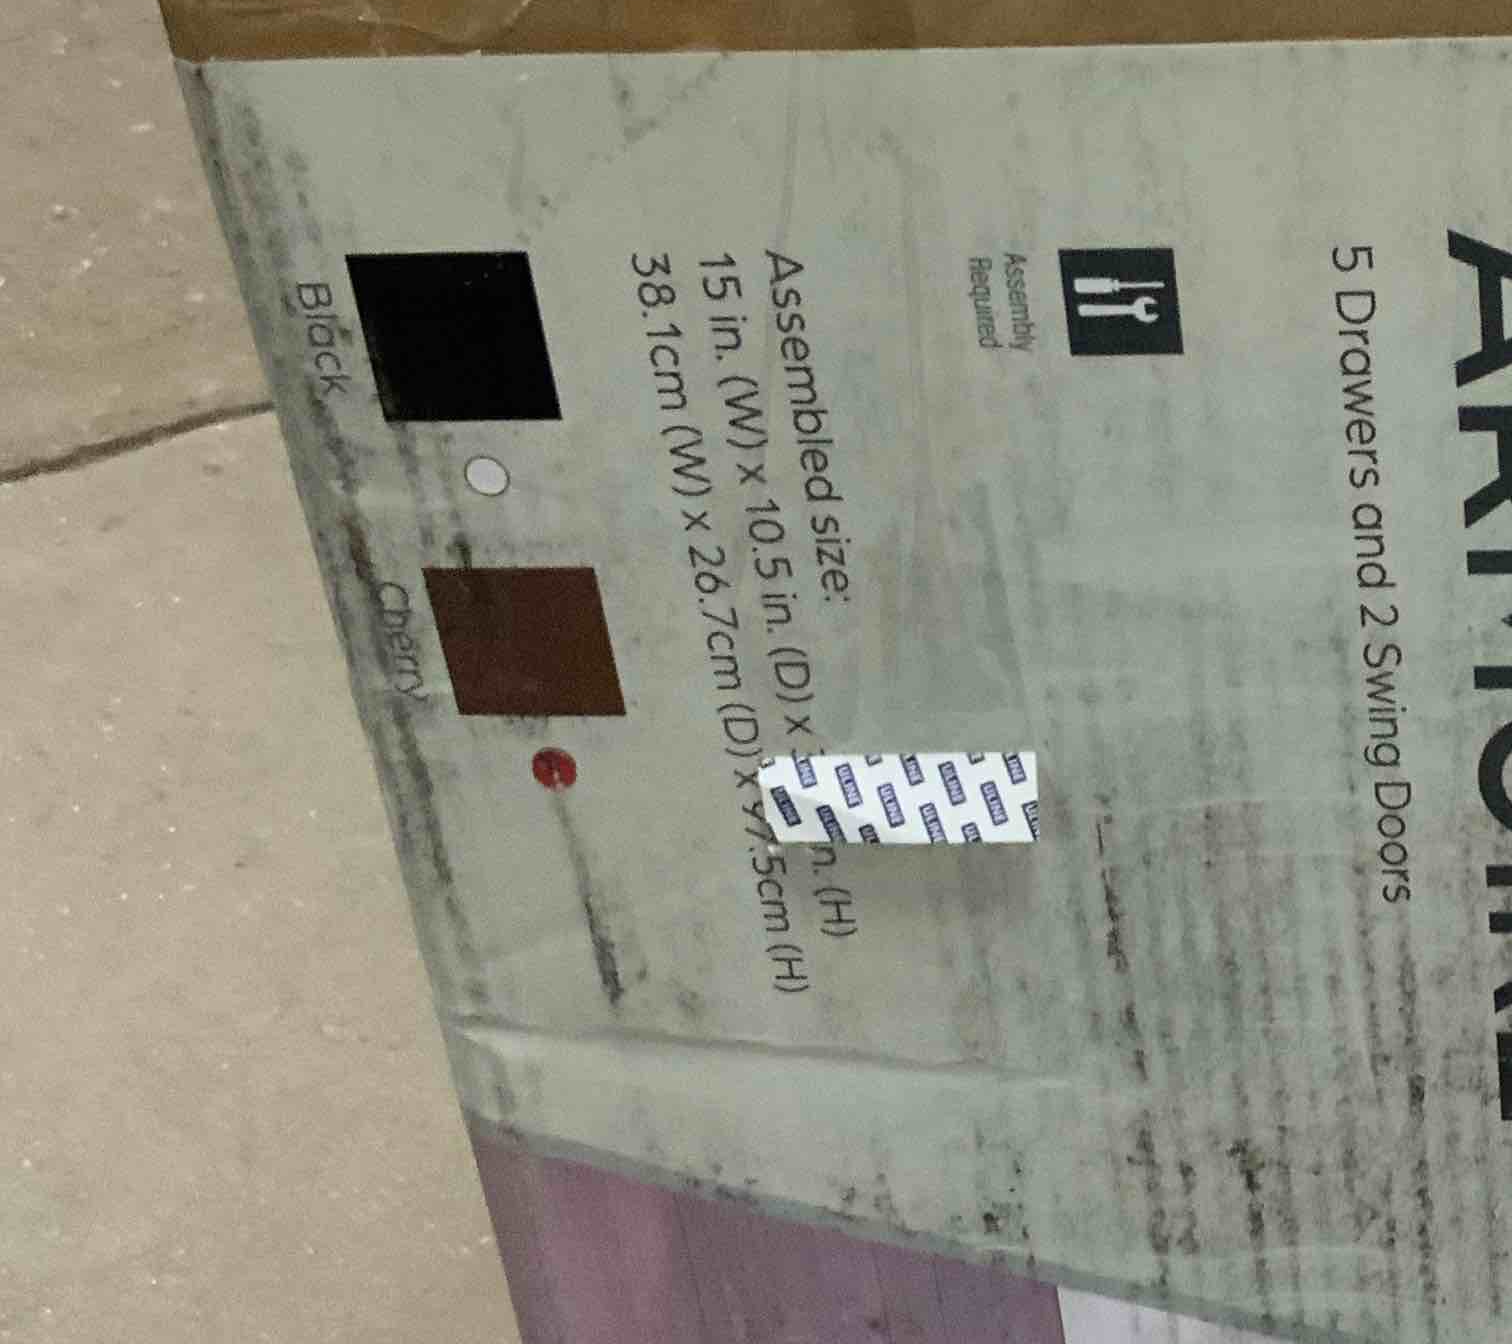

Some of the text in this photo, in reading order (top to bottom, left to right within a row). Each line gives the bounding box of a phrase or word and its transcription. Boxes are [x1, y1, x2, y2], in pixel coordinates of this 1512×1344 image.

[698, 252, 743, 301] 15
[967, 255, 1004, 352] Required
[1003, 253, 1038, 353] Assembly
[296, 280, 349, 395] Black
[630, 252, 689, 412] 38.1cm
[708, 315, 748, 362] in.
[716, 375, 769, 450] (W)
[764, 249, 852, 603] Assembled size:
[660, 424, 714, 498] (W)
[735, 462, 768, 485] x
[680, 510, 713, 533] x
[745, 498, 794, 580] 10.5
[1331, 246, 1412, 905] 5 Drawers and 2 Swing Doors
[687, 544, 743, 691] 26.7cm
[760, 591, 798, 635] in.
[374, 579, 429, 705] Cherry
[767, 646, 816, 704] (D)
[716, 702, 763, 758] (D)
[783, 714, 814, 736] x
[770, 786, 801, 827] ULINE
[835, 763, 864, 808] ULINE
[877, 782, 906, 829] ULINE
[938, 760, 967, 806] ULINE
[980, 780, 1009, 826] ULINE
[809, 841, 839, 876] n.
[812, 886, 858, 938] (H)
[765, 943, 810, 994] (H)
